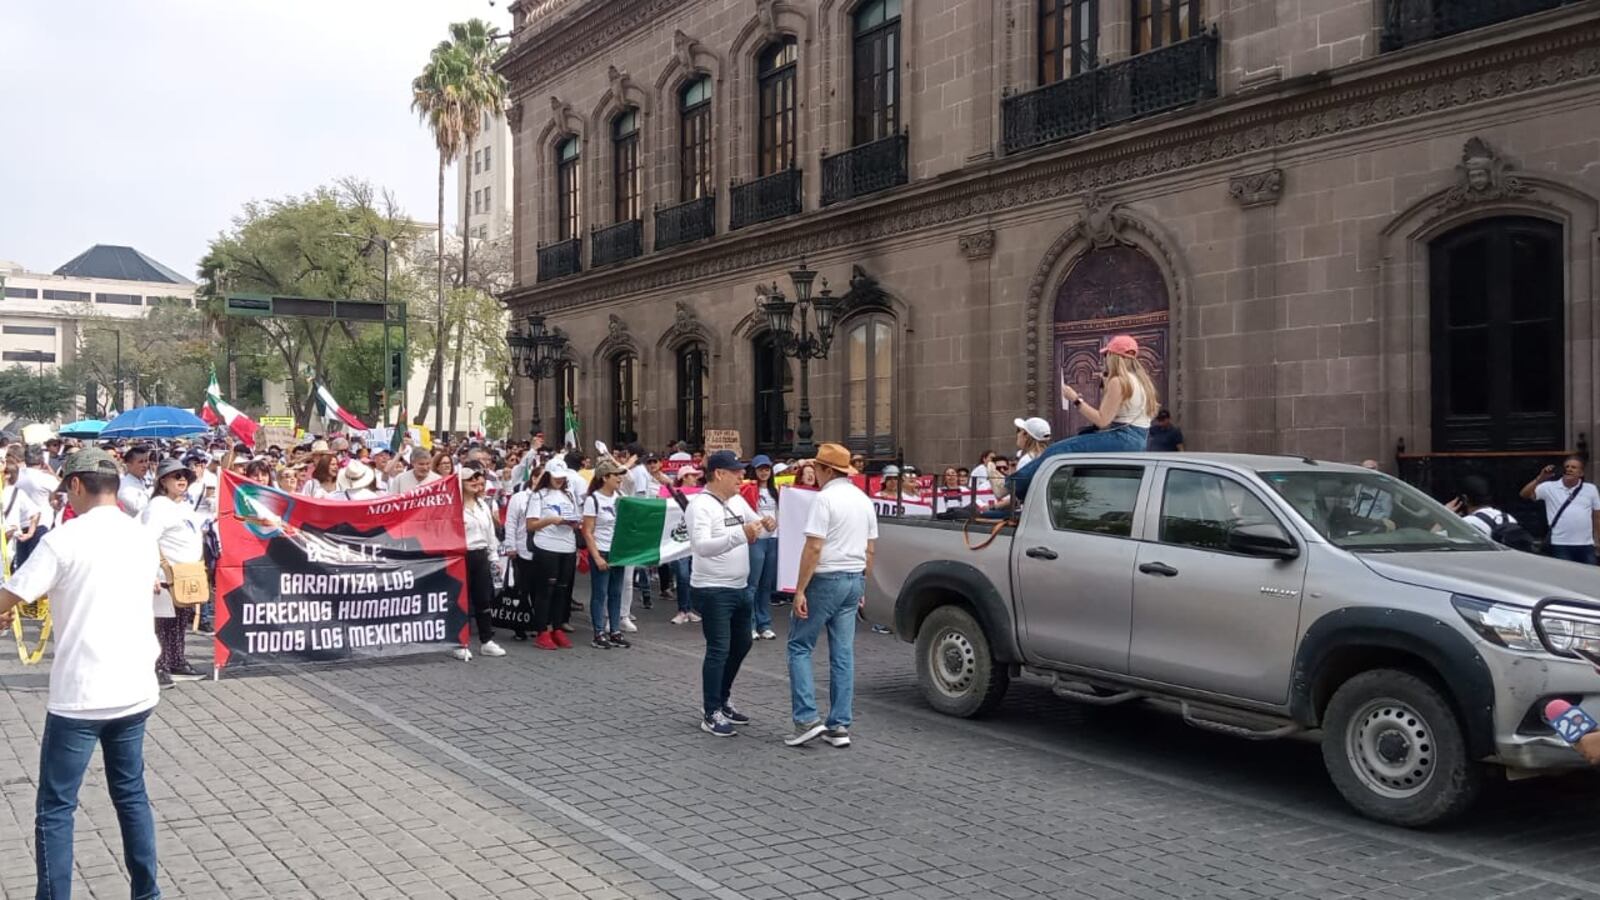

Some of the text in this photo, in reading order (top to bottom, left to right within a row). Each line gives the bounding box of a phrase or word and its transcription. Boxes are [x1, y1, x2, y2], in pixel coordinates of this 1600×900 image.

[367, 493, 455, 515] MONTERREY
[281, 570, 414, 595] GARANTIZA LOS
[242, 592, 448, 624] DERECHOS HUMANOS DE
[245, 619, 445, 653] TODOS LOS MEXICANOS
